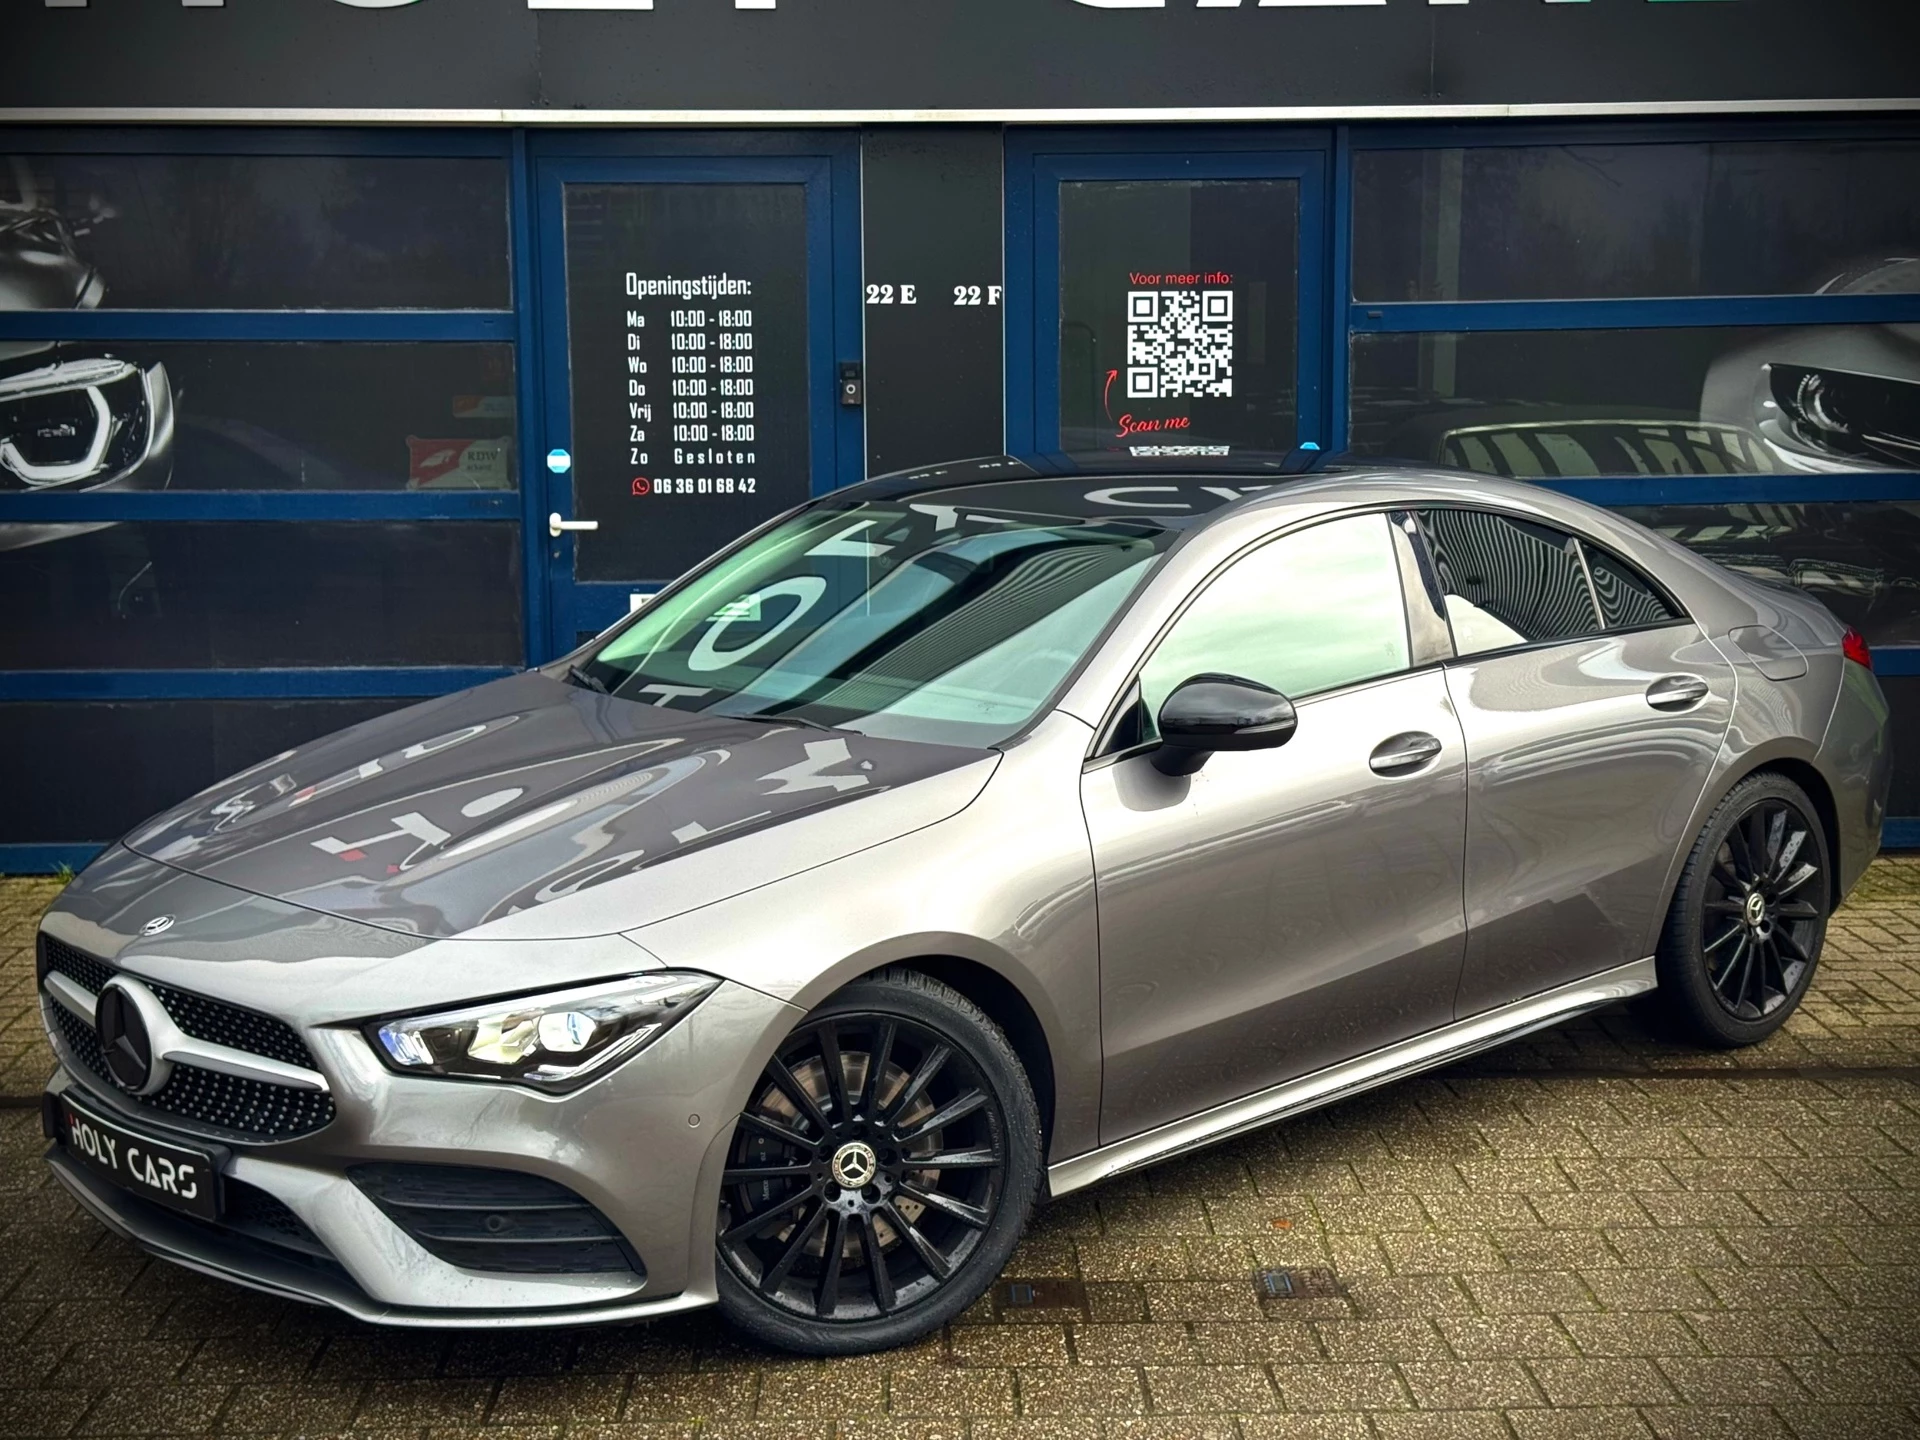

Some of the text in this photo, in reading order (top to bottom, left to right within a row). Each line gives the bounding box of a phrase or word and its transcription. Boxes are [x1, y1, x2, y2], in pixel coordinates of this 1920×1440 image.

[626, 272, 752, 300] Openingstijden:
[1129, 271, 1234, 285] Voor meer info:
[866, 284, 917, 304] 22 E
[953, 285, 1003, 306] 22 F
[627, 310, 645, 327] Ma
[670, 310, 705, 327] 10:00
[719, 310, 752, 327] 18:00
[627, 333, 640, 350] Di
[671, 333, 706, 350] 10:00
[719, 333, 753, 350] 18:00
[628, 356, 647, 373] Wo
[672, 356, 706, 373] 10:00
[720, 356, 753, 373] 18:00
[629, 379, 646, 396] Do
[672, 379, 707, 396] 10:00
[720, 379, 753, 396] 18:00
[629, 402, 652, 422] Vrij
[673, 401, 708, 419] 10:00
[720, 401, 754, 418] 18:00
[630, 425, 645, 442] Za
[673, 424, 708, 441] 10:00
[721, 424, 755, 441] 18:00
[1115, 414, 1190, 438] Scan me
[467, 451, 499, 462] RDW
[630, 447, 756, 465] Zo Gesloten
[653, 478, 756, 494] 06 36 01 68 42
[69, 1114, 197, 1200] HOLY CARS
